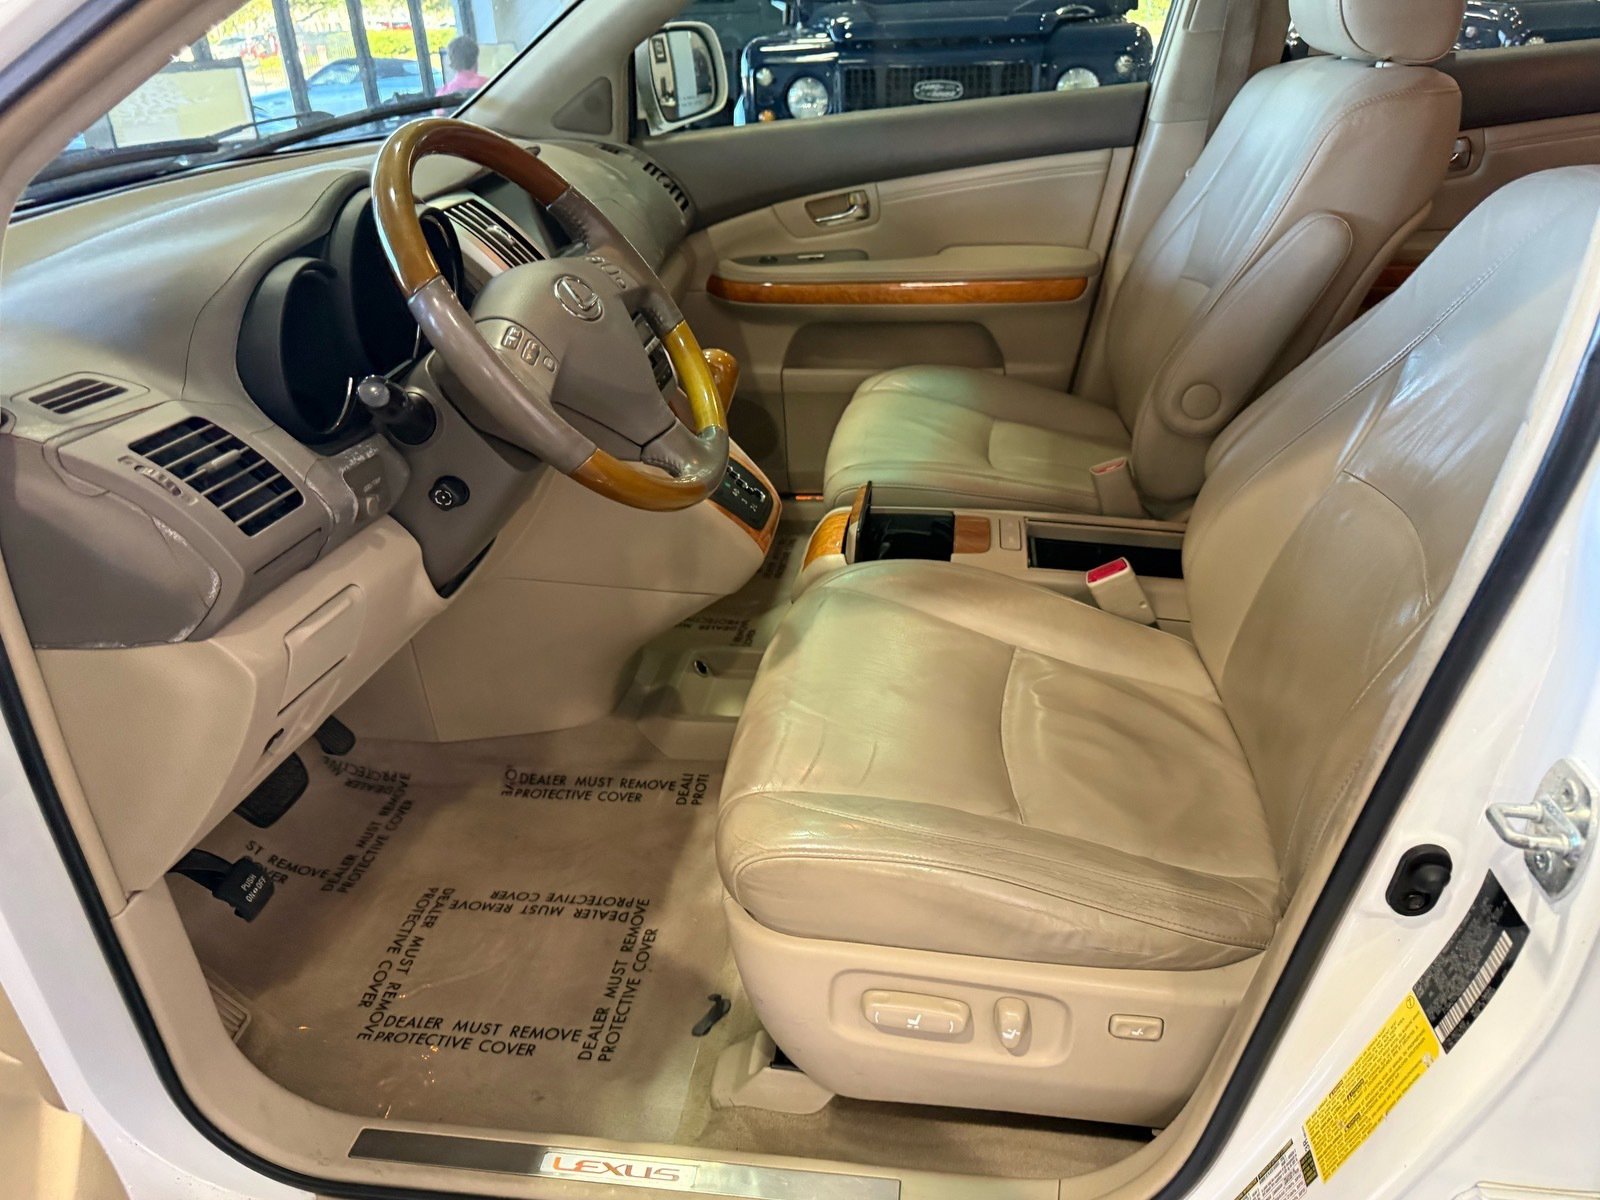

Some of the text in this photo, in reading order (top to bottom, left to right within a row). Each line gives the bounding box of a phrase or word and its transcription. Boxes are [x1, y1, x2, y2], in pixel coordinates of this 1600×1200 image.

[519, 772, 677, 792] DEALER MUST REMOVE
[514, 788, 643, 803] PROTECTIVE COVER
[321, 854, 359, 892] DEALER
[356, 821, 382, 848] MUST
[336, 799, 413, 894] PROTECTIVE COVER
[267, 854, 331, 879] REMOVE
[241, 874, 257, 892] PUSH
[245, 876, 267, 903] ON OFF
[449, 899, 631, 922] DEALER MUST REMOVE
[489, 889, 640, 908] PROTECTIVE COVER
[358, 886, 439, 1009] PROTECTIVE COVER
[357, 887, 456, 1041] DEALER MUST REMOVE
[577, 898, 650, 1061] DEALER MUST REMOVE
[597, 927, 659, 1062] PROTECTIVE COVER
[383, 1014, 584, 1043] DEALER MUST REMOVE
[374, 1031, 537, 1057] PROTECTIVE COVER
[553, 1156, 681, 1182] LEXUS
